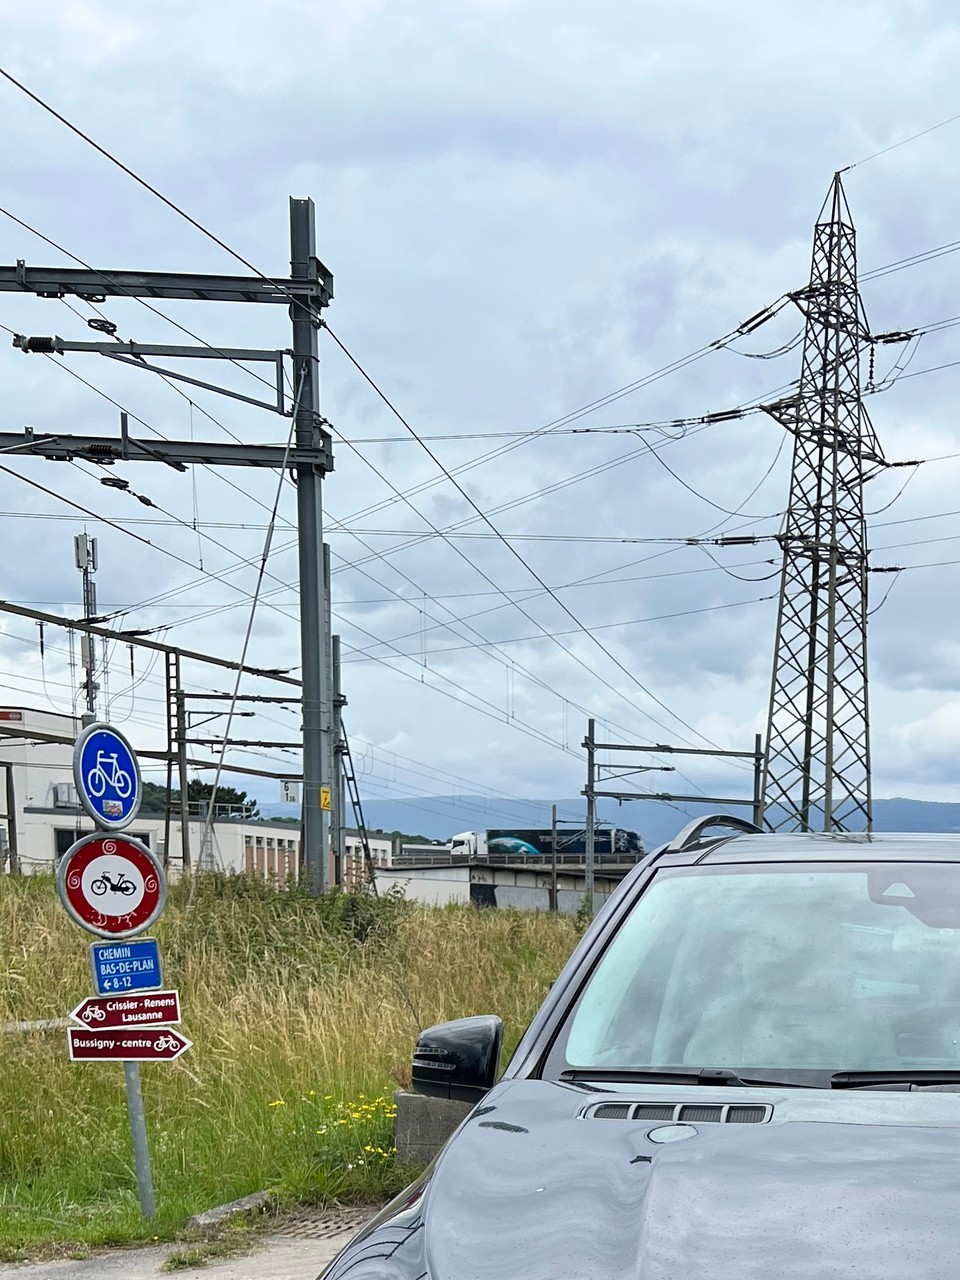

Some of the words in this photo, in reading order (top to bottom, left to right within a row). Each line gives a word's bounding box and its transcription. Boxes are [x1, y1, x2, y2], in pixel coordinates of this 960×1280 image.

[98, 947, 131, 960] CHEMIN
[100, 959, 154, 975] BAS-DE-PLAN
[113, 976, 132, 989] 8-12
[106, 1000, 138, 1011] Crissier
[144, 998, 175, 1008] Renens
[122, 1011, 163, 1022] Lausanne
[73, 1038, 115, 1050] Bussigny
[122, 1039, 152, 1048] centre
